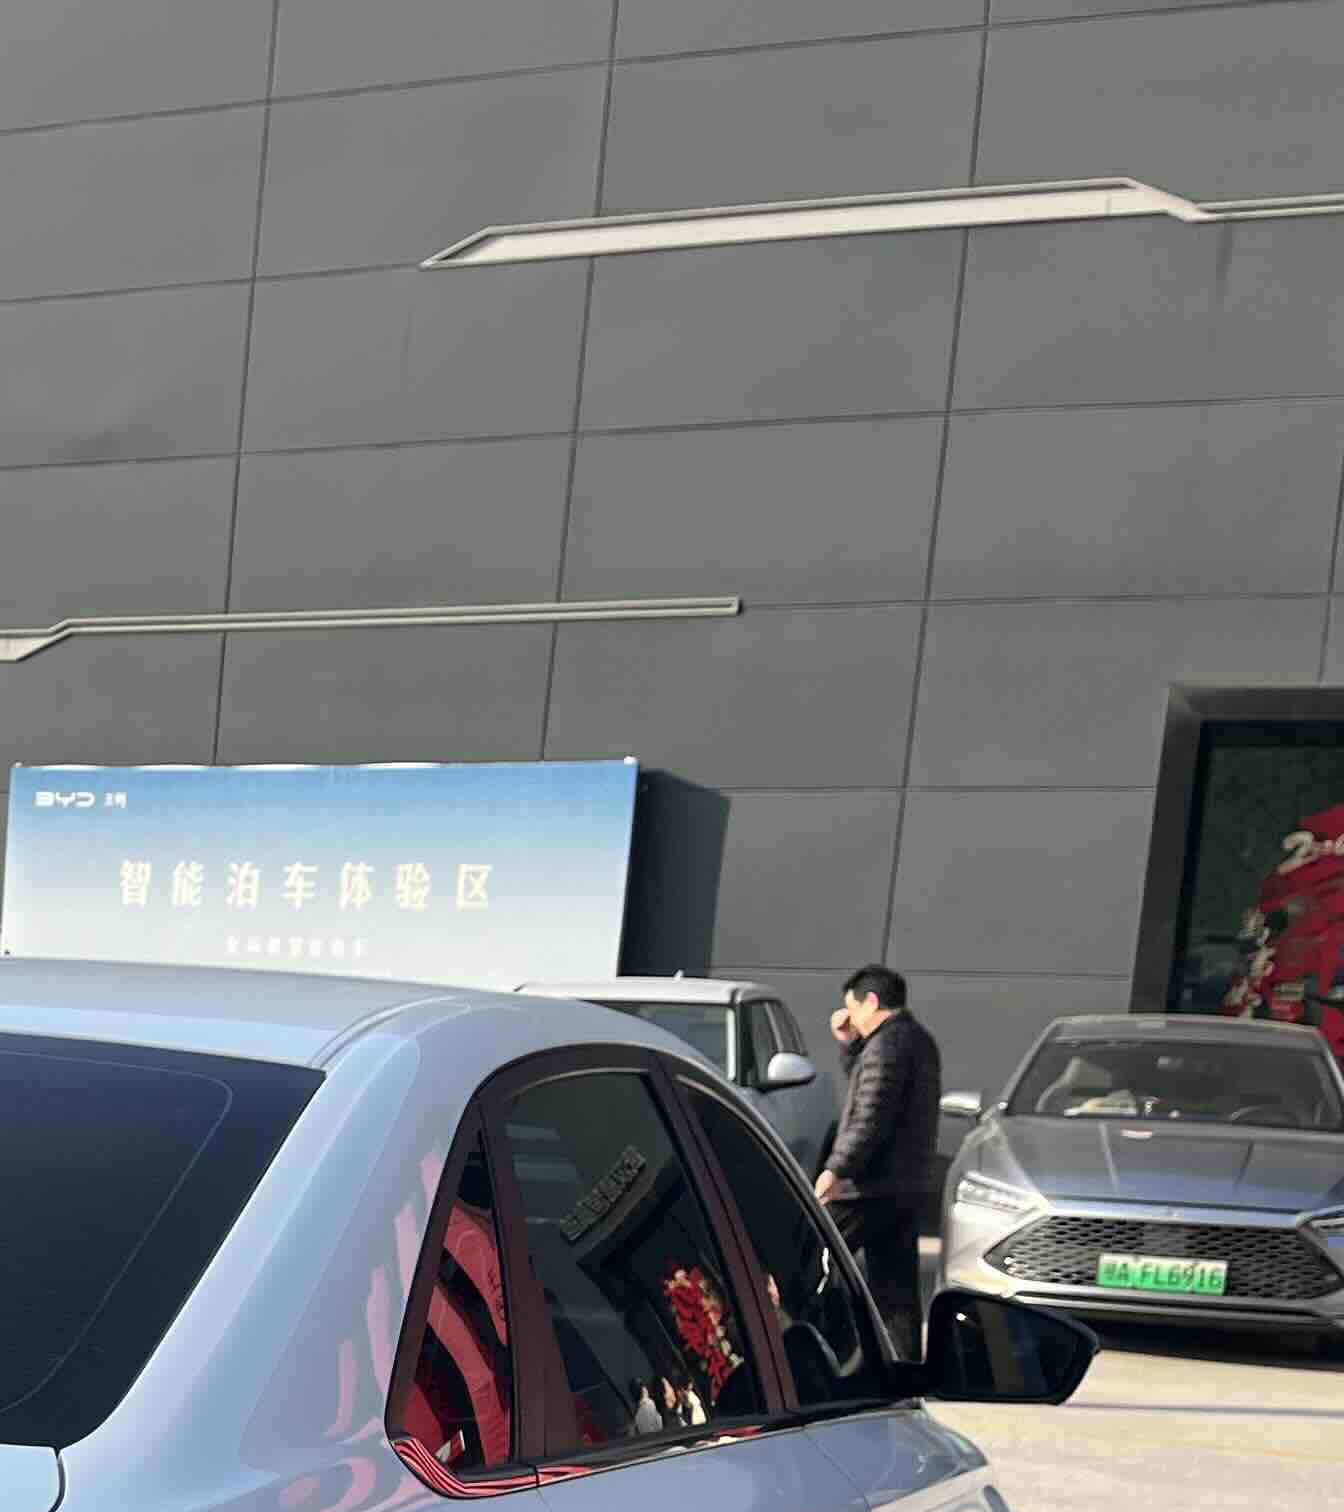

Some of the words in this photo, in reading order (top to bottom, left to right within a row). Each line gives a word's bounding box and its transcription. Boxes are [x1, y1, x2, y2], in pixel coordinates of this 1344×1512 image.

[35, 791, 96, 809] BYD
[118, 859, 494, 911] 智能泊车体验区
